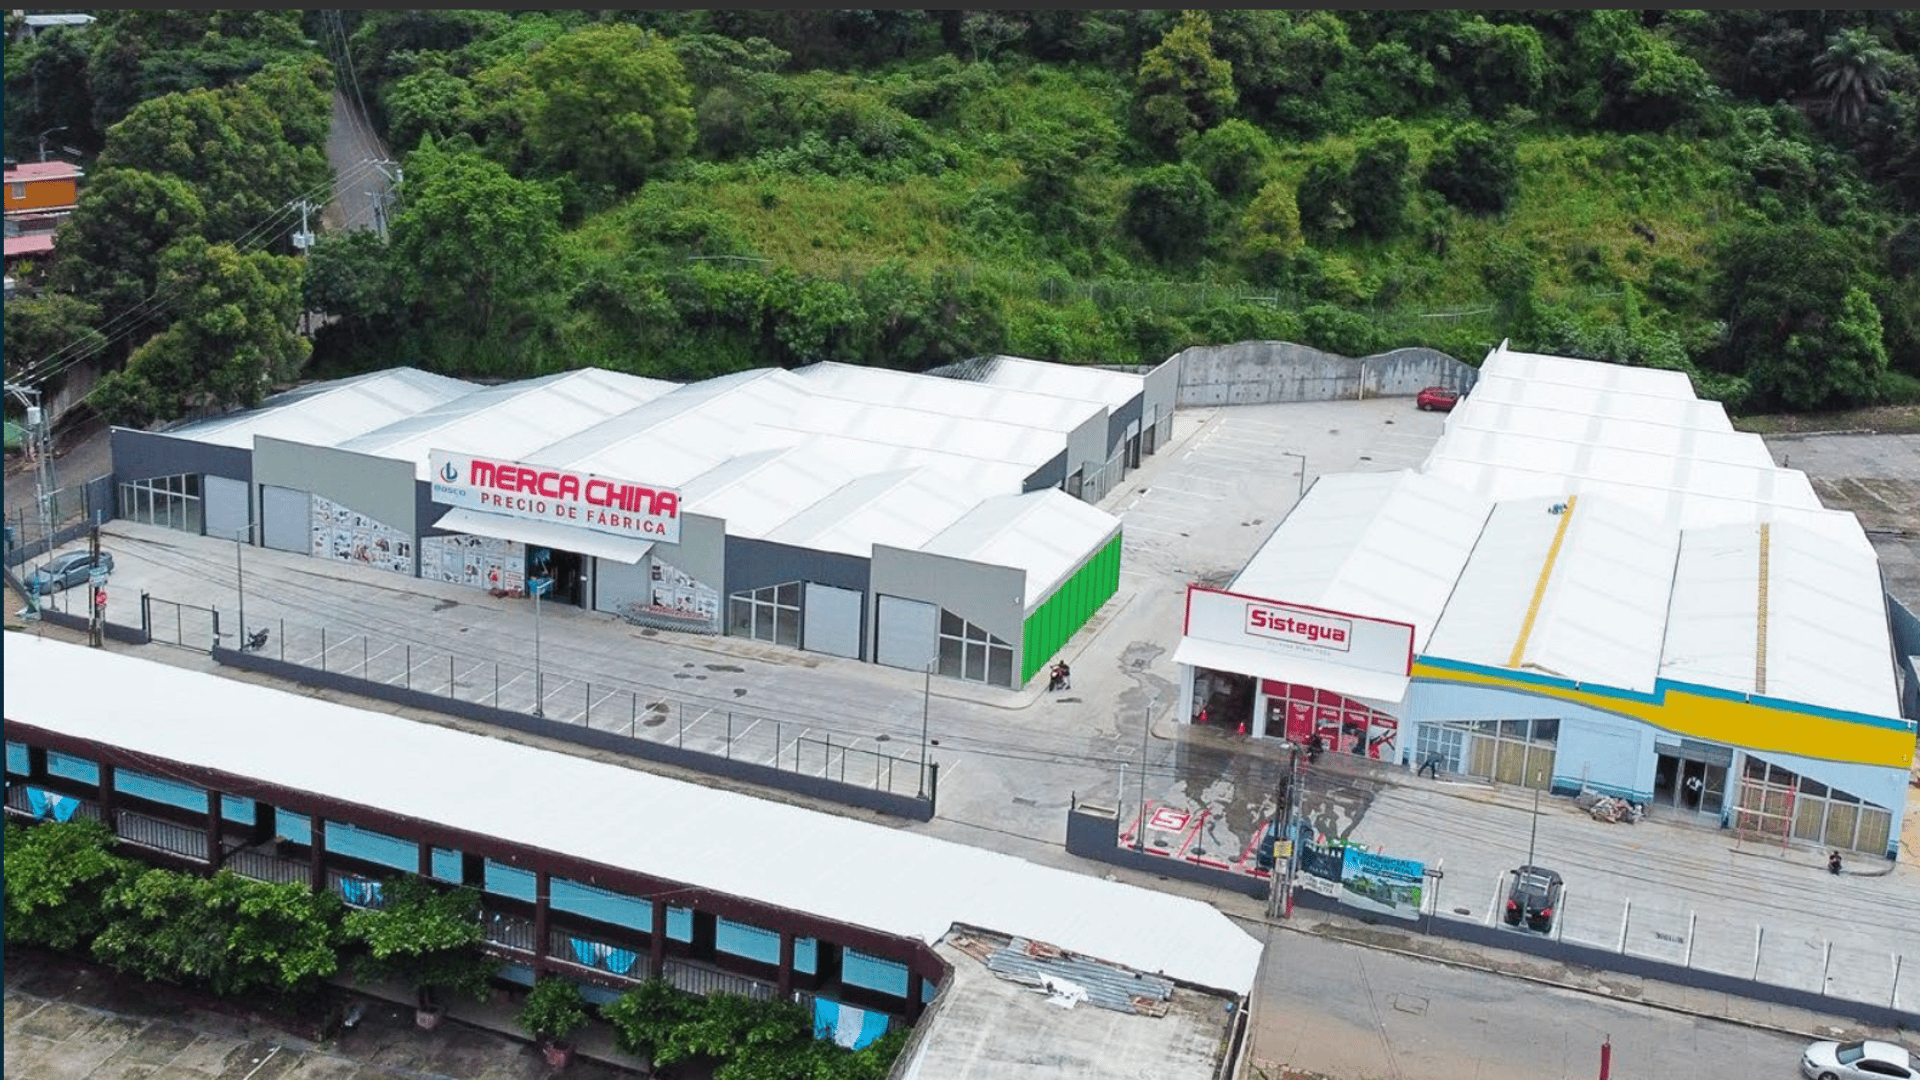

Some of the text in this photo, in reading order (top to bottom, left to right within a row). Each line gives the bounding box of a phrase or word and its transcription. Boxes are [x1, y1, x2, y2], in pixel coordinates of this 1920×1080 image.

[470, 460, 678, 519] MERCA CHINA
[481, 492, 546, 514] PRECIO
[556, 505, 577, 519] DE
[1251, 609, 1345, 642] Sistegua
